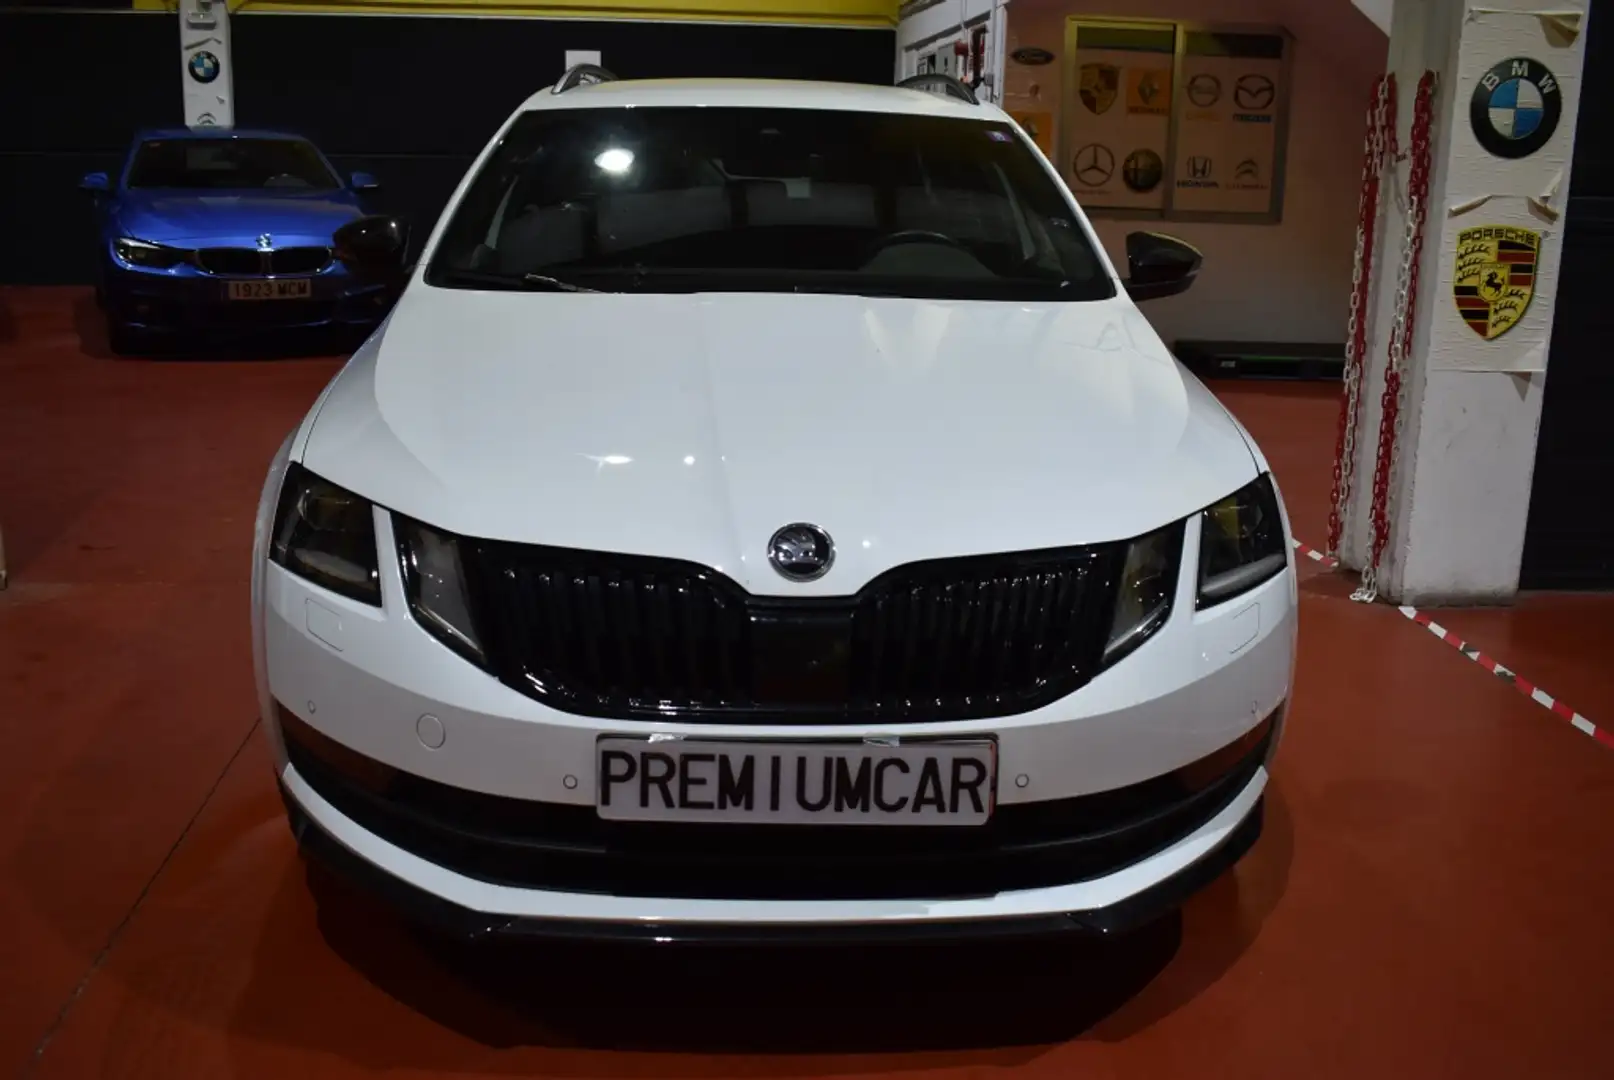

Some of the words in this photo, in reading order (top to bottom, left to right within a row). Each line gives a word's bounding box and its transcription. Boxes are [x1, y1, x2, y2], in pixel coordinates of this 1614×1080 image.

[1481, 60, 1557, 94] BMW
[1459, 228, 1535, 246] PORSCHE
[235, 282, 273, 297] 1923
[600, 750, 987, 814] PREMIUMCAR
